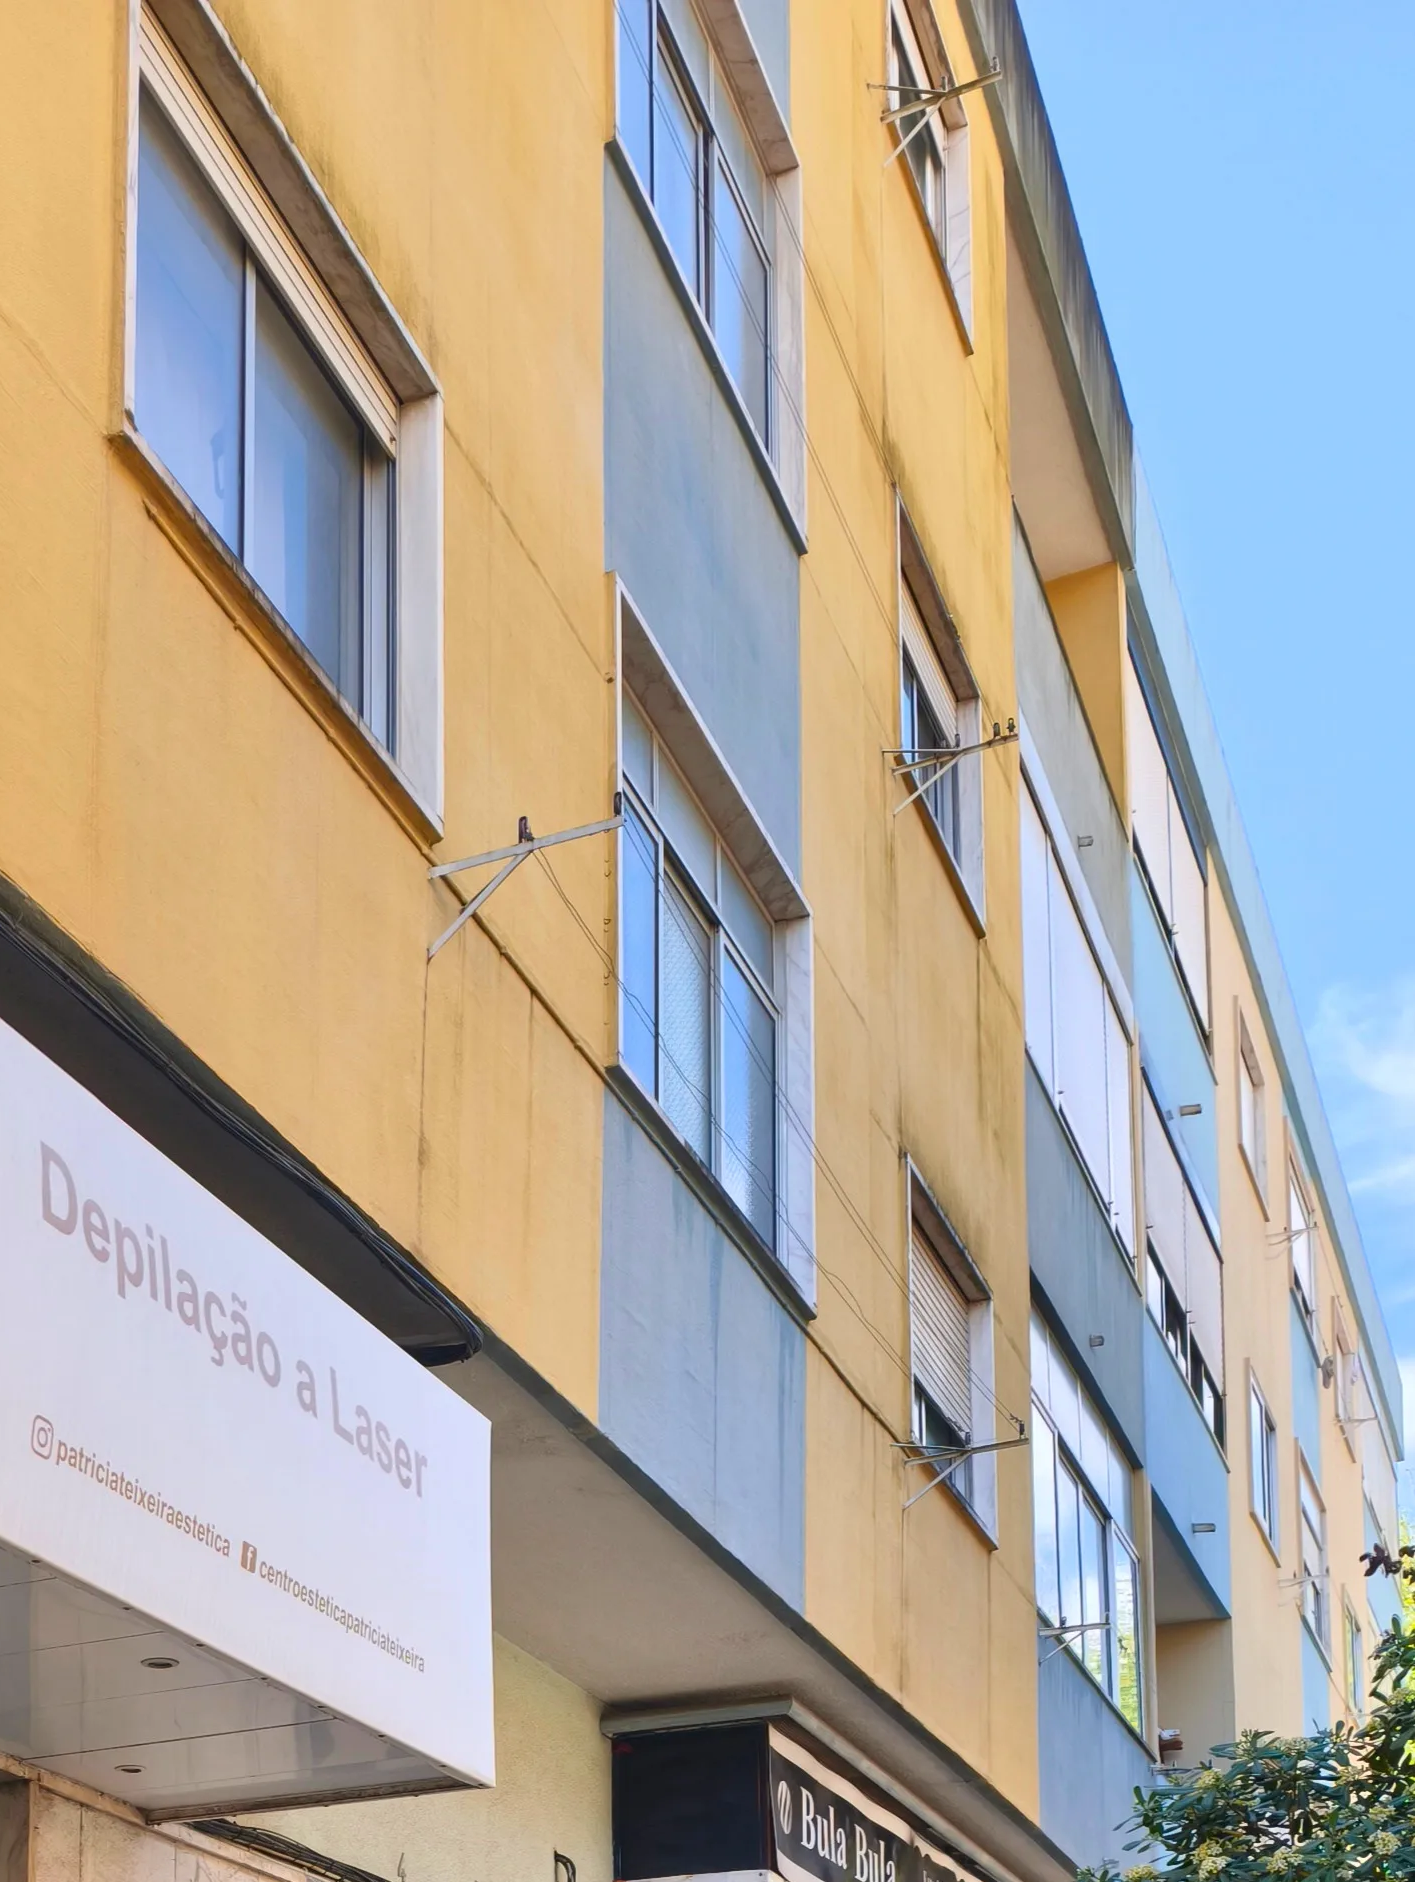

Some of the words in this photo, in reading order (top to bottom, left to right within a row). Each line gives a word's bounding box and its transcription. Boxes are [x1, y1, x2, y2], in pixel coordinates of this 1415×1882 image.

[41, 1142, 280, 1387] Depilação
[296, 1360, 317, 1418] a
[331, 1368, 428, 1498] Laser
[56, 1439, 231, 1558] patriciateixeiraestetica
[259, 1560, 425, 1673] centroesteticapatriciateixeira
[800, 1786, 847, 1870] Bula
